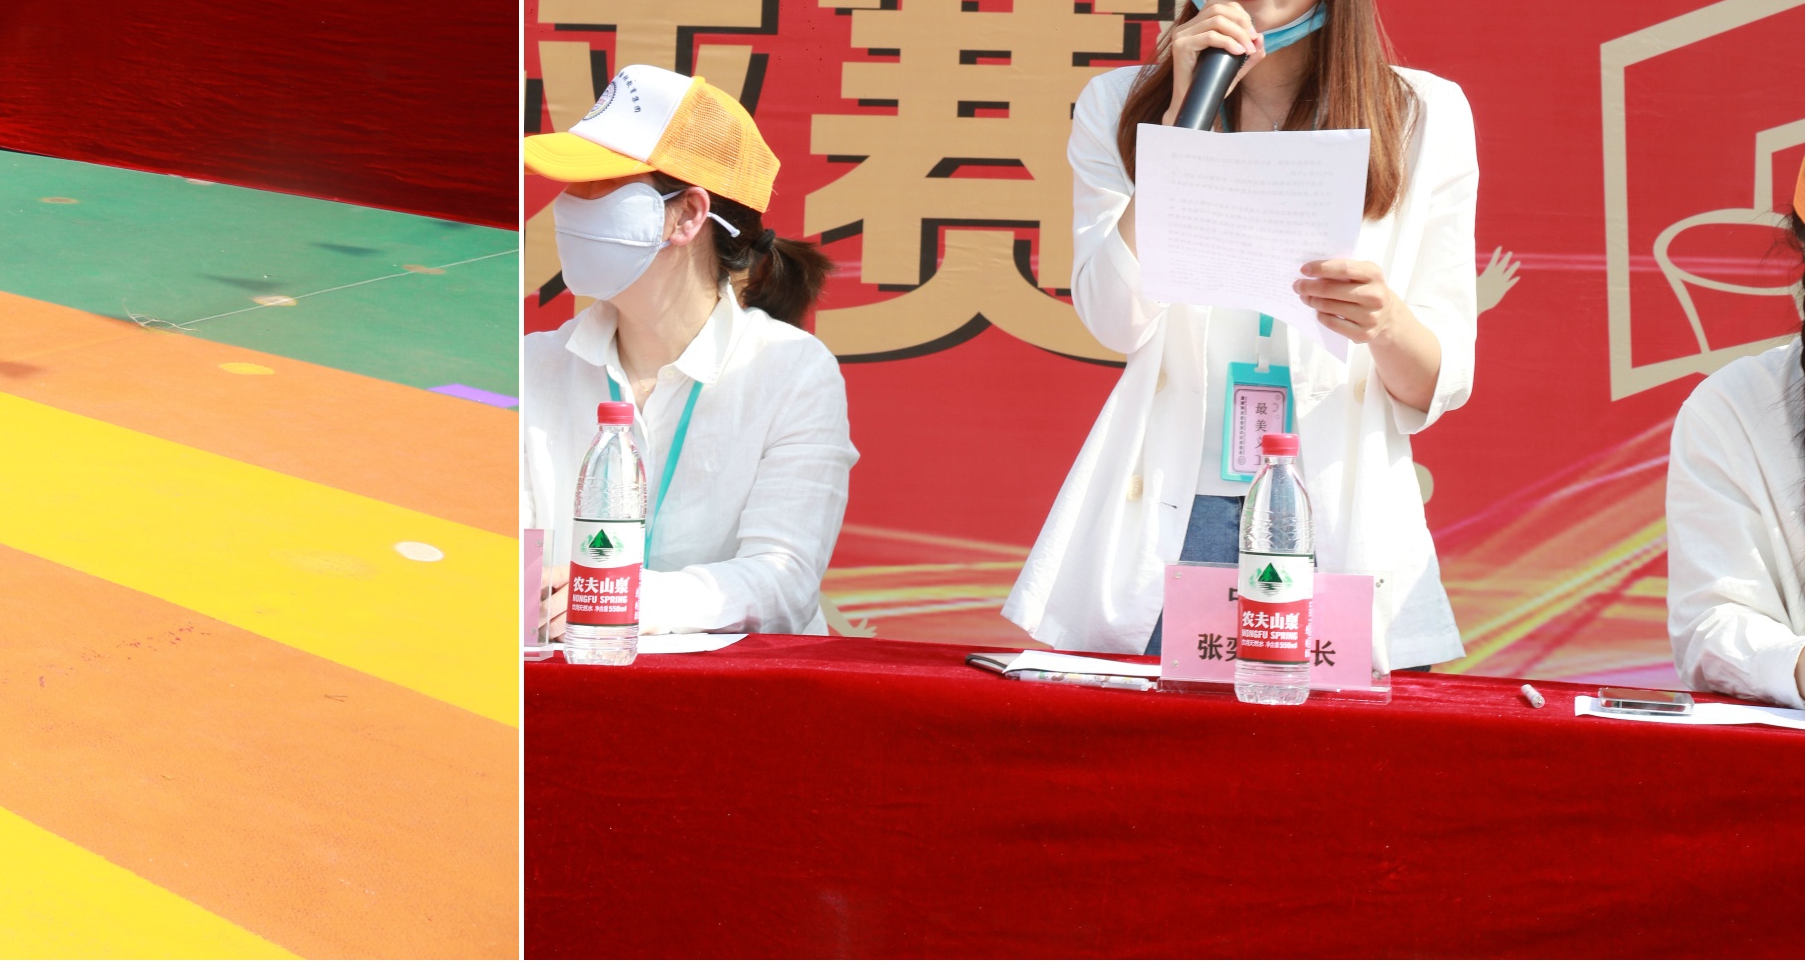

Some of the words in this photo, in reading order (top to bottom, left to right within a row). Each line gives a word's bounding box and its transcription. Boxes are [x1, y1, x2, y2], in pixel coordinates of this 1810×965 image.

[573, 576, 631, 594] 农夫山泉
[600, 595, 628, 604] SPRING
[1241, 611, 1301, 630] 农夫山泉
[1270, 631, 1299, 640] SPRING
